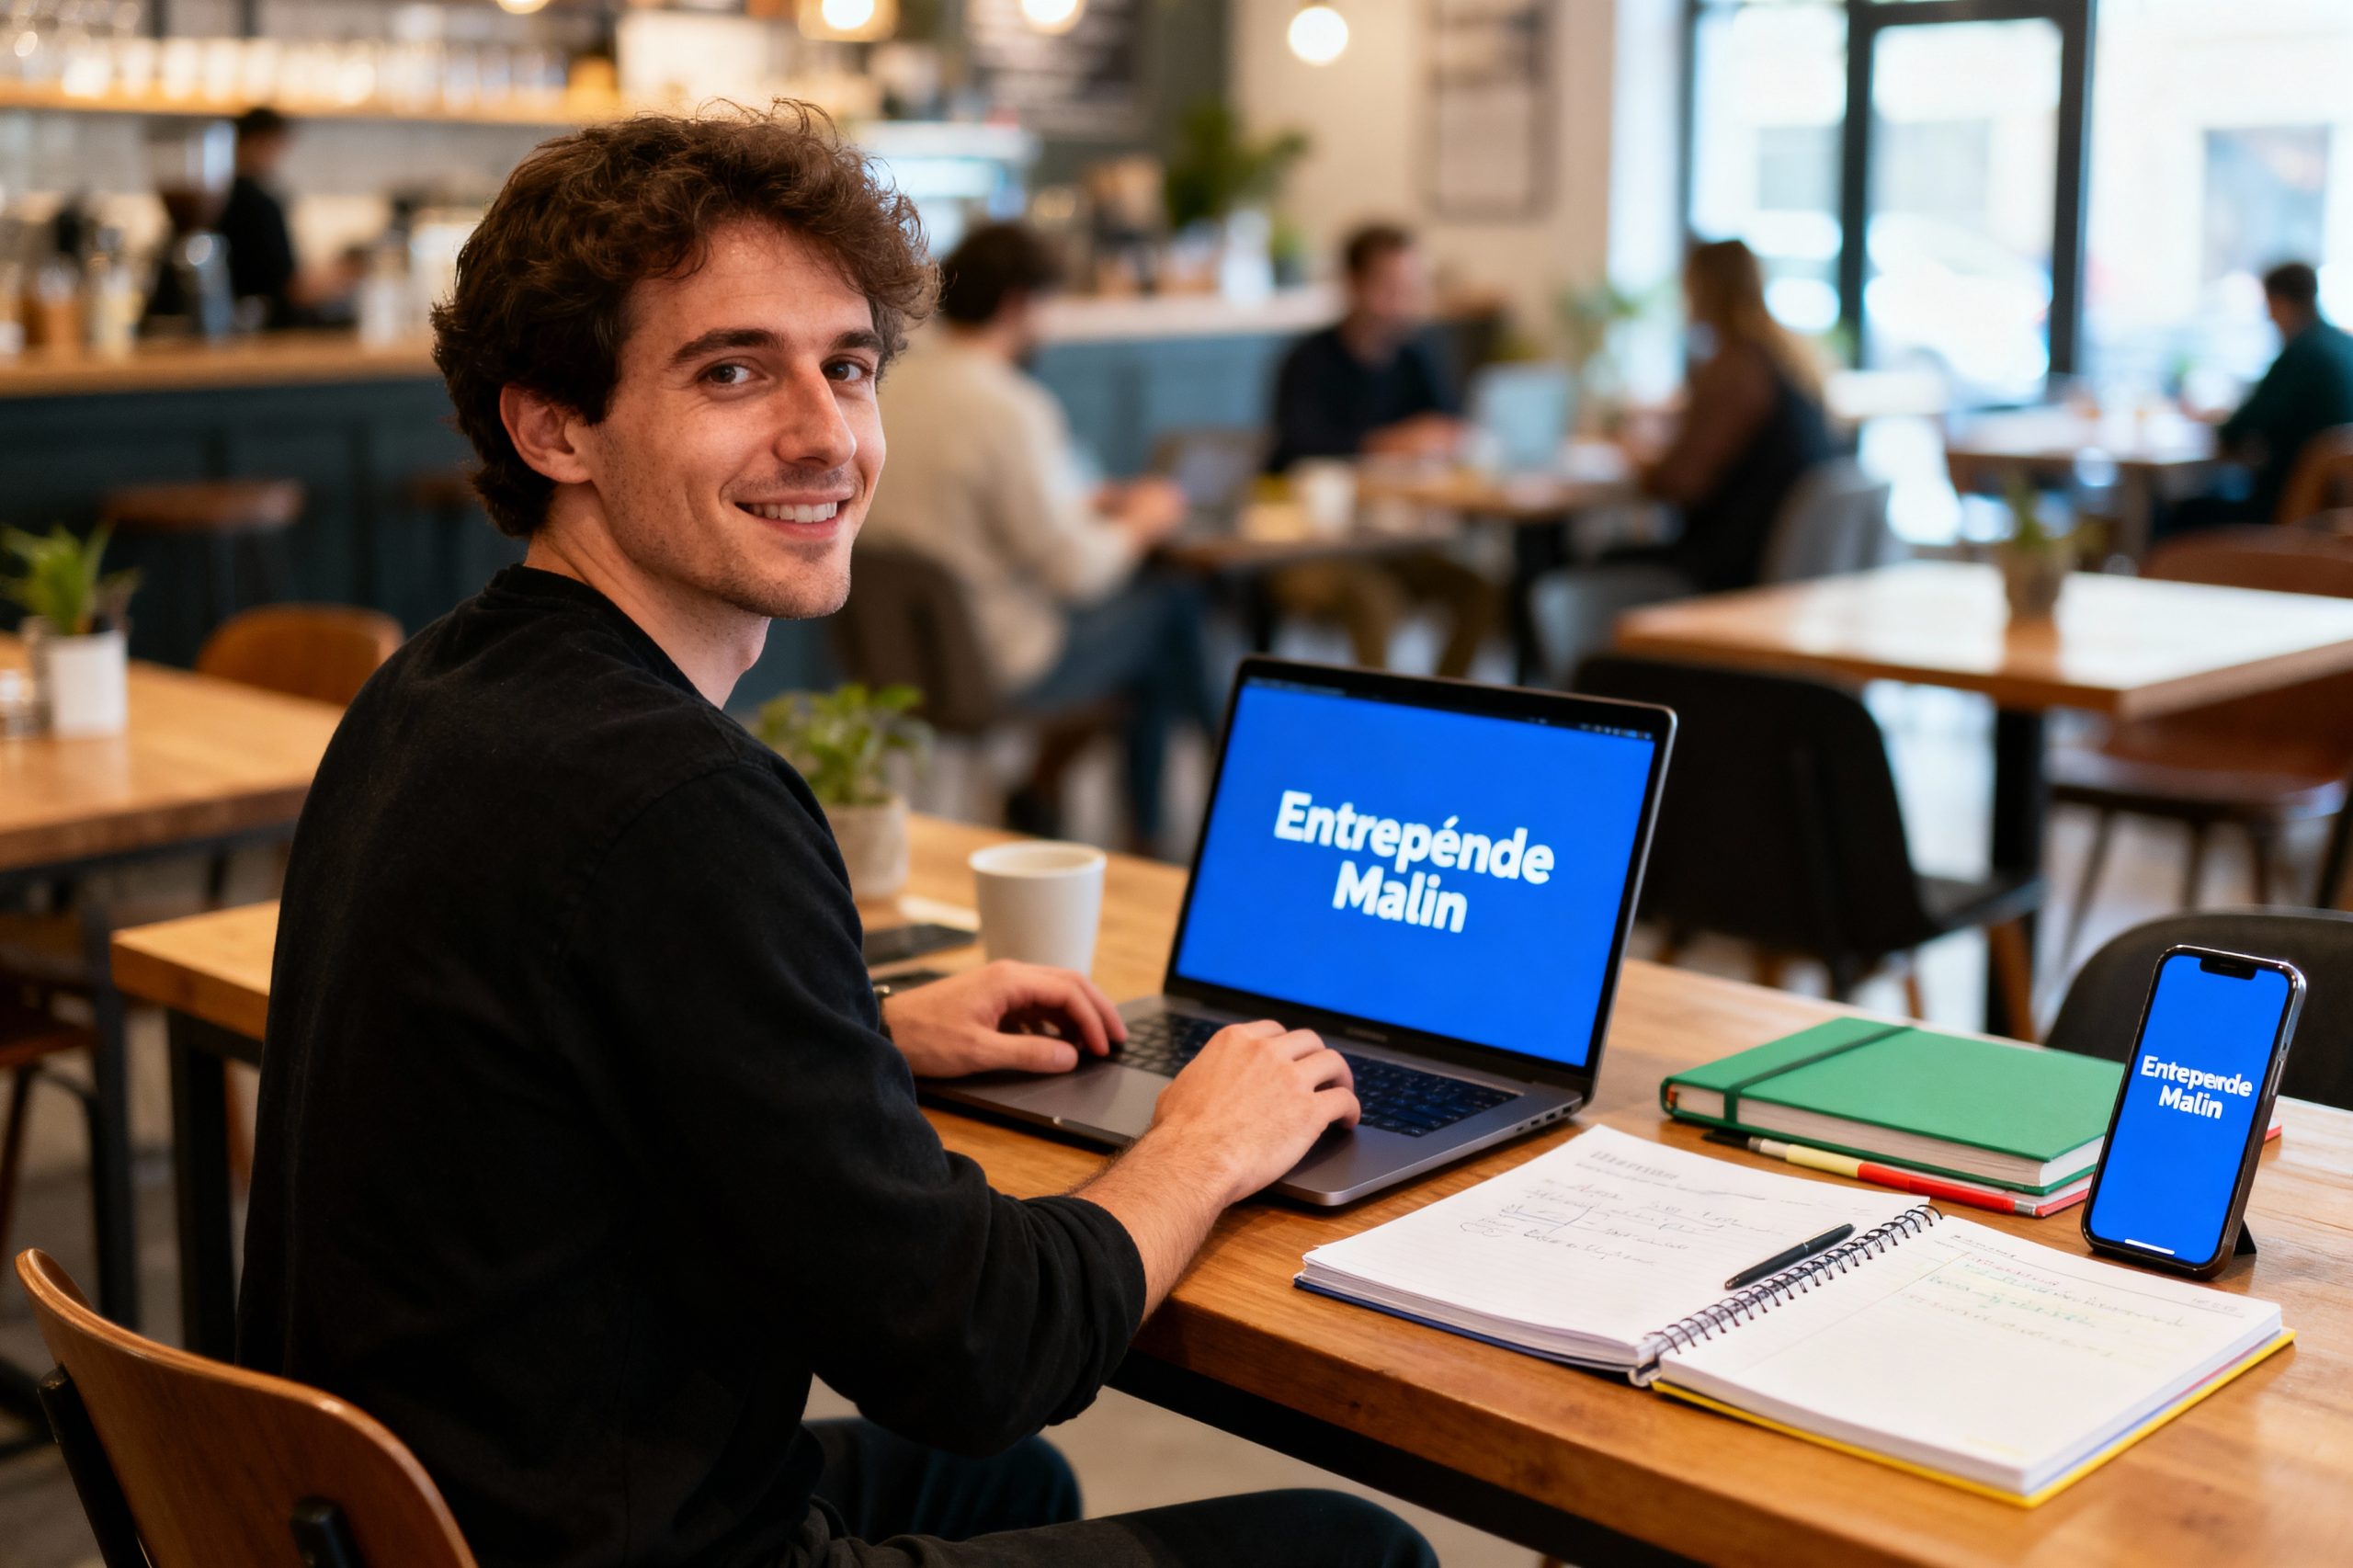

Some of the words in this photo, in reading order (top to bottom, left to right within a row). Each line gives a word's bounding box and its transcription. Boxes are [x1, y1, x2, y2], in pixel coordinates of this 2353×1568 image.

[1274, 790, 1555, 884] Entrepénde
[1332, 859, 1468, 933] Malin
[2158, 1085, 2223, 1119] Malin
